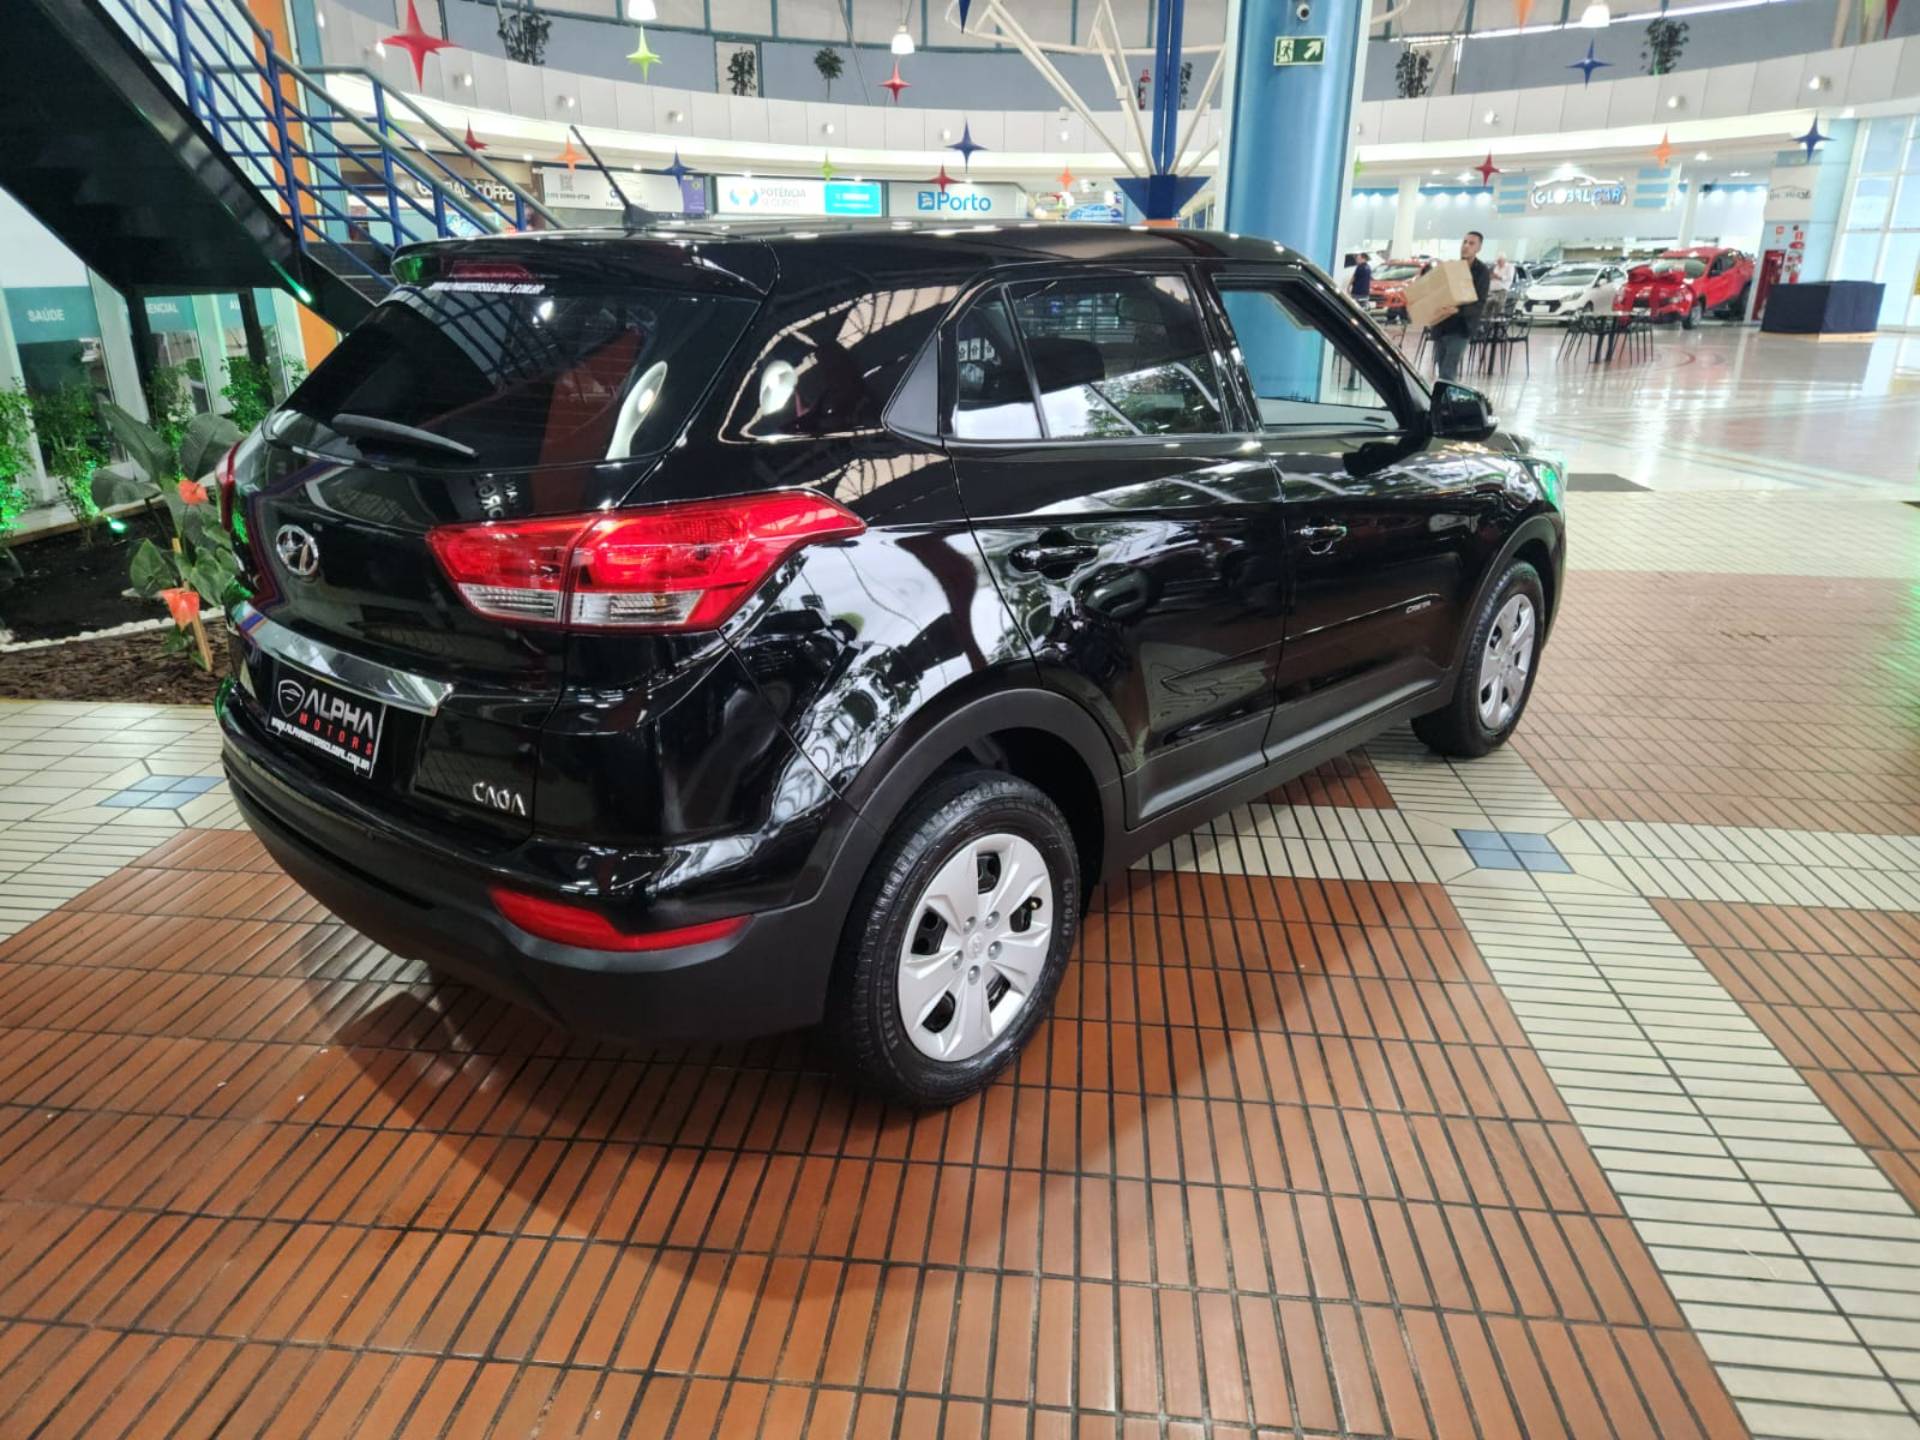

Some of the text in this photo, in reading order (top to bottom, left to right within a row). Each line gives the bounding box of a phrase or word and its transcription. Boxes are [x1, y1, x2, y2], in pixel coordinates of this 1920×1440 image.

[937, 192, 991, 211] Porto
[27, 307, 65, 322] SAÚDE
[304, 688, 374, 739] ALPHA
[299, 711, 374, 756] MOTORS
[472, 781, 526, 816] CAOA
